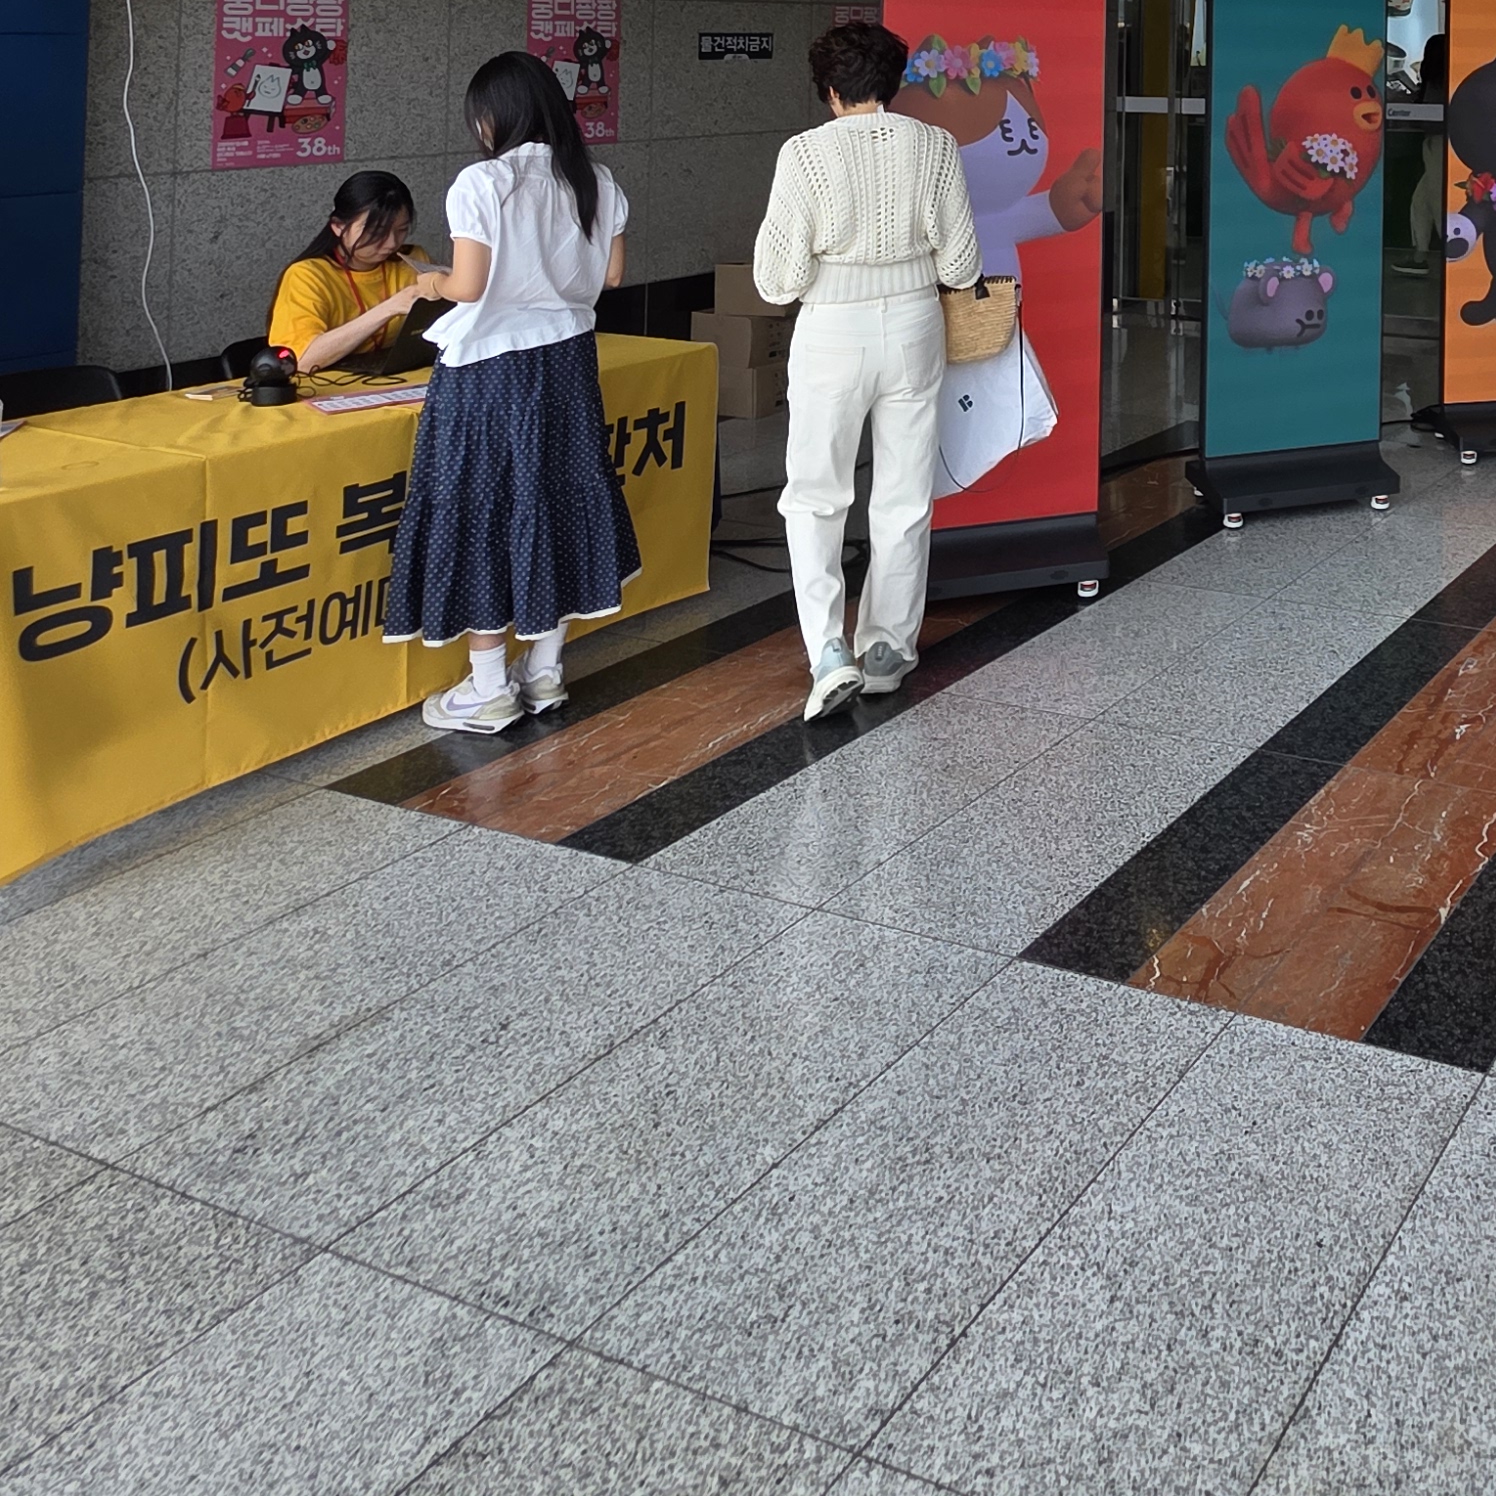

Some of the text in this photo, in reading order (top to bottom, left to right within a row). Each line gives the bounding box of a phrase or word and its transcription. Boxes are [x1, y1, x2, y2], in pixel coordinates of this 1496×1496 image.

[700, 36, 772, 52] 물건적치금지
[584, 121, 615, 139] 38th
[296, 137, 341, 157] 38th
[12, 500, 311, 662] 냥피또
